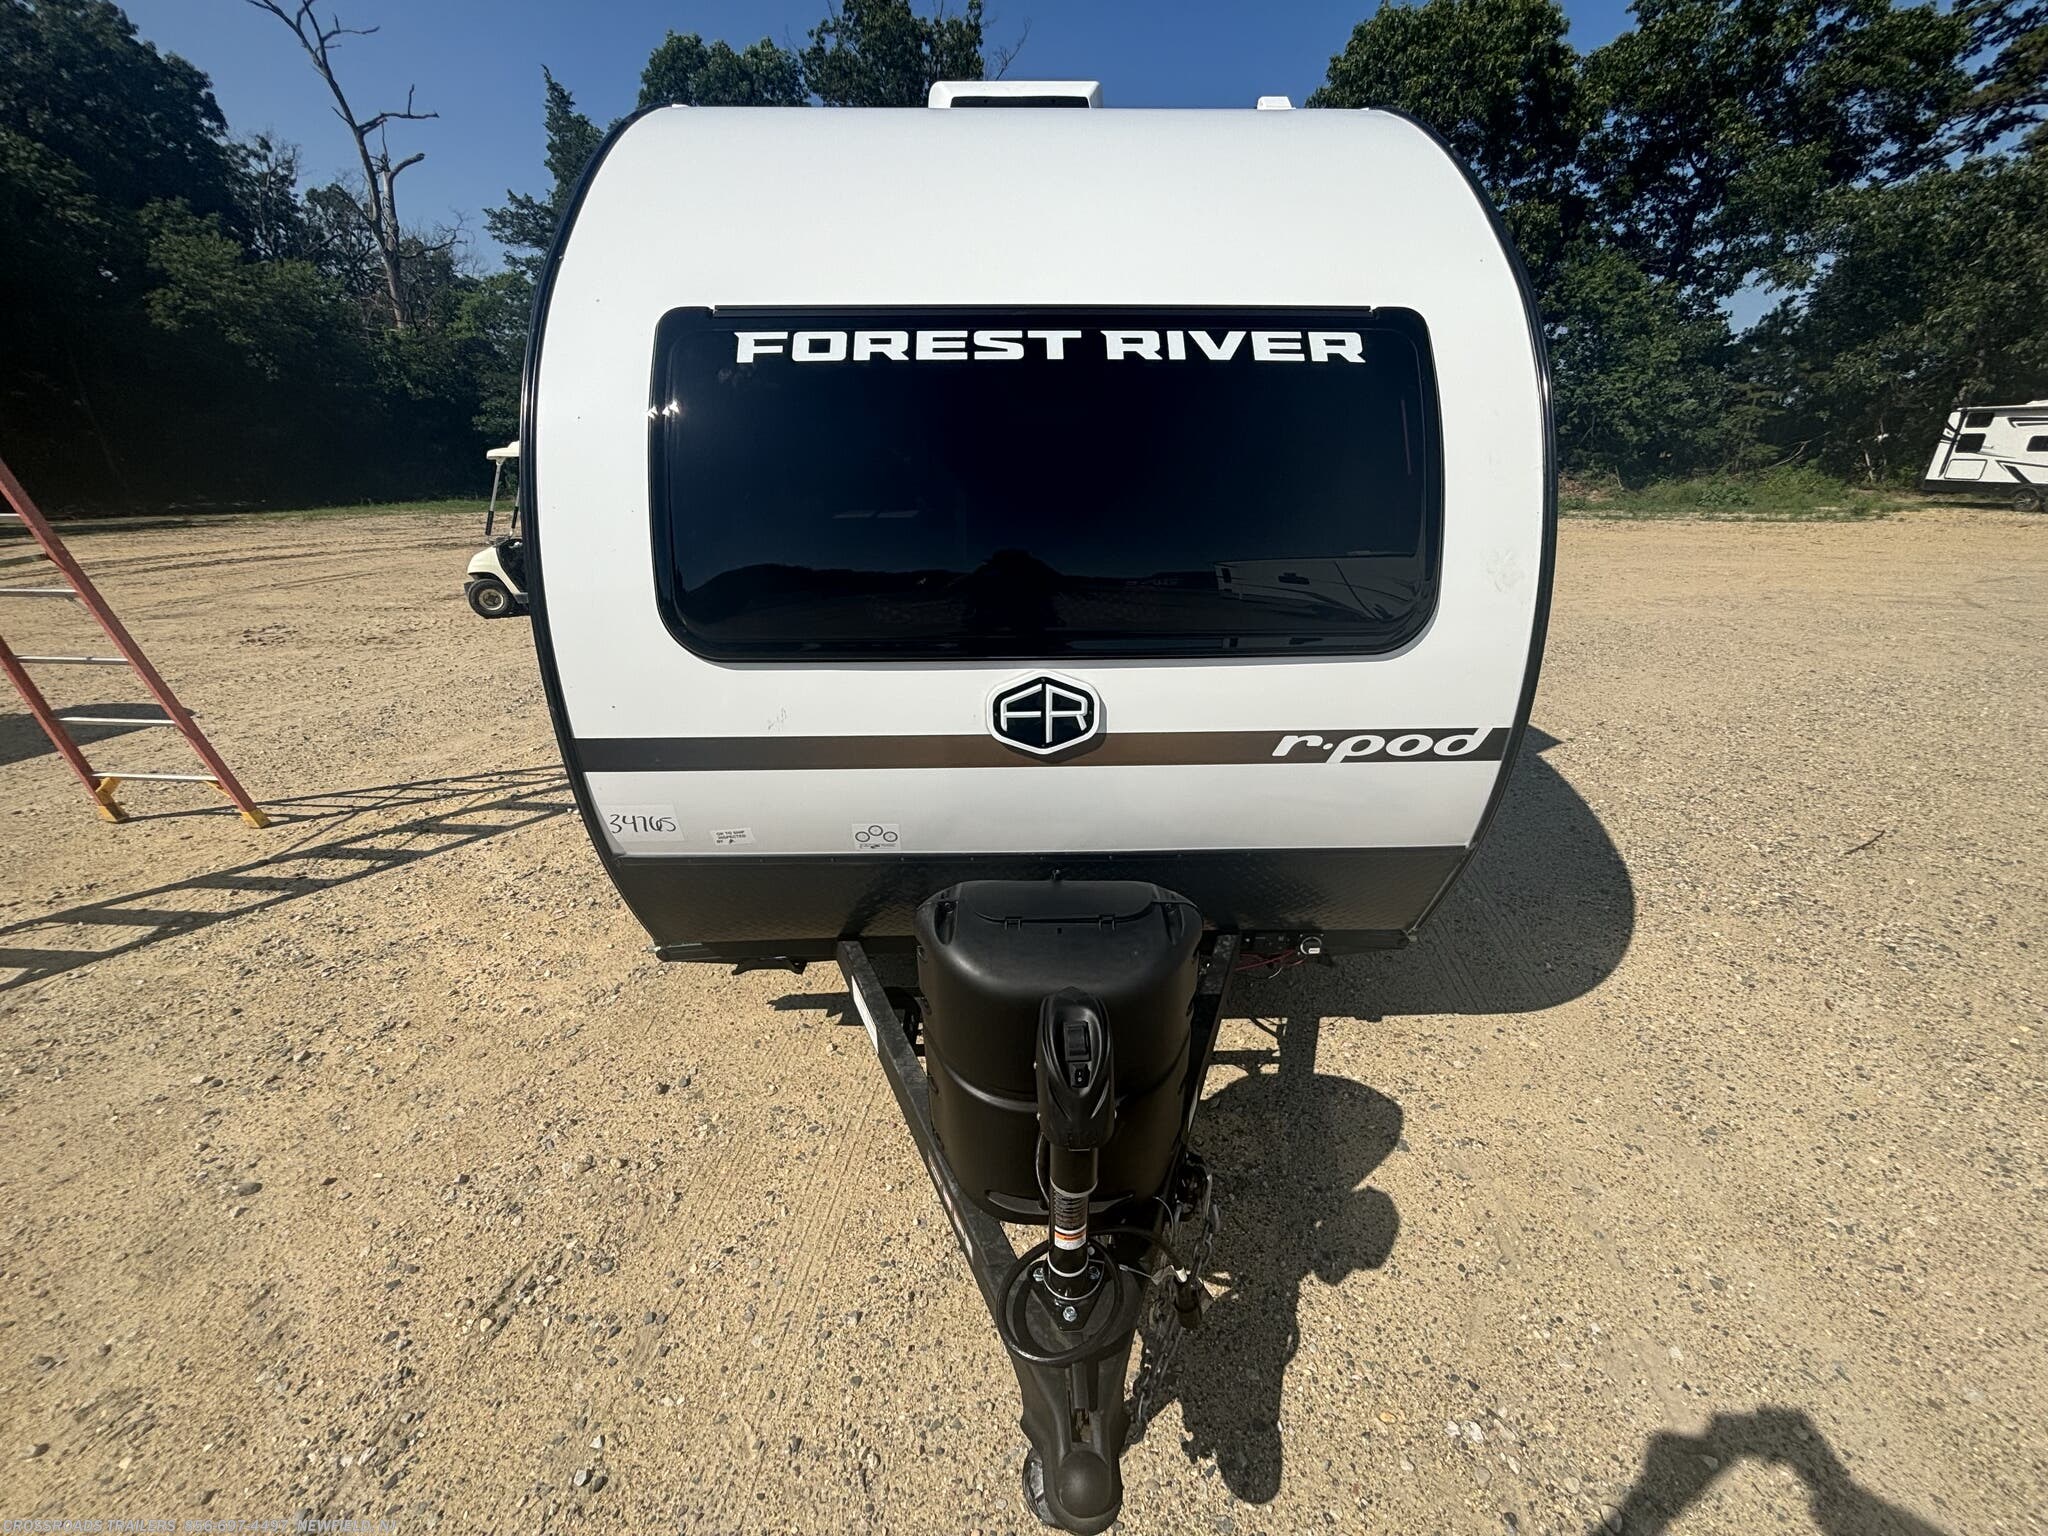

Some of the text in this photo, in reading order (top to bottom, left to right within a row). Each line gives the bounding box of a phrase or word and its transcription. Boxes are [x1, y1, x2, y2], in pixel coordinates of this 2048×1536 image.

[734, 330, 1366, 364] FOREST RIVER
[609, 813, 677, 834] 34765
